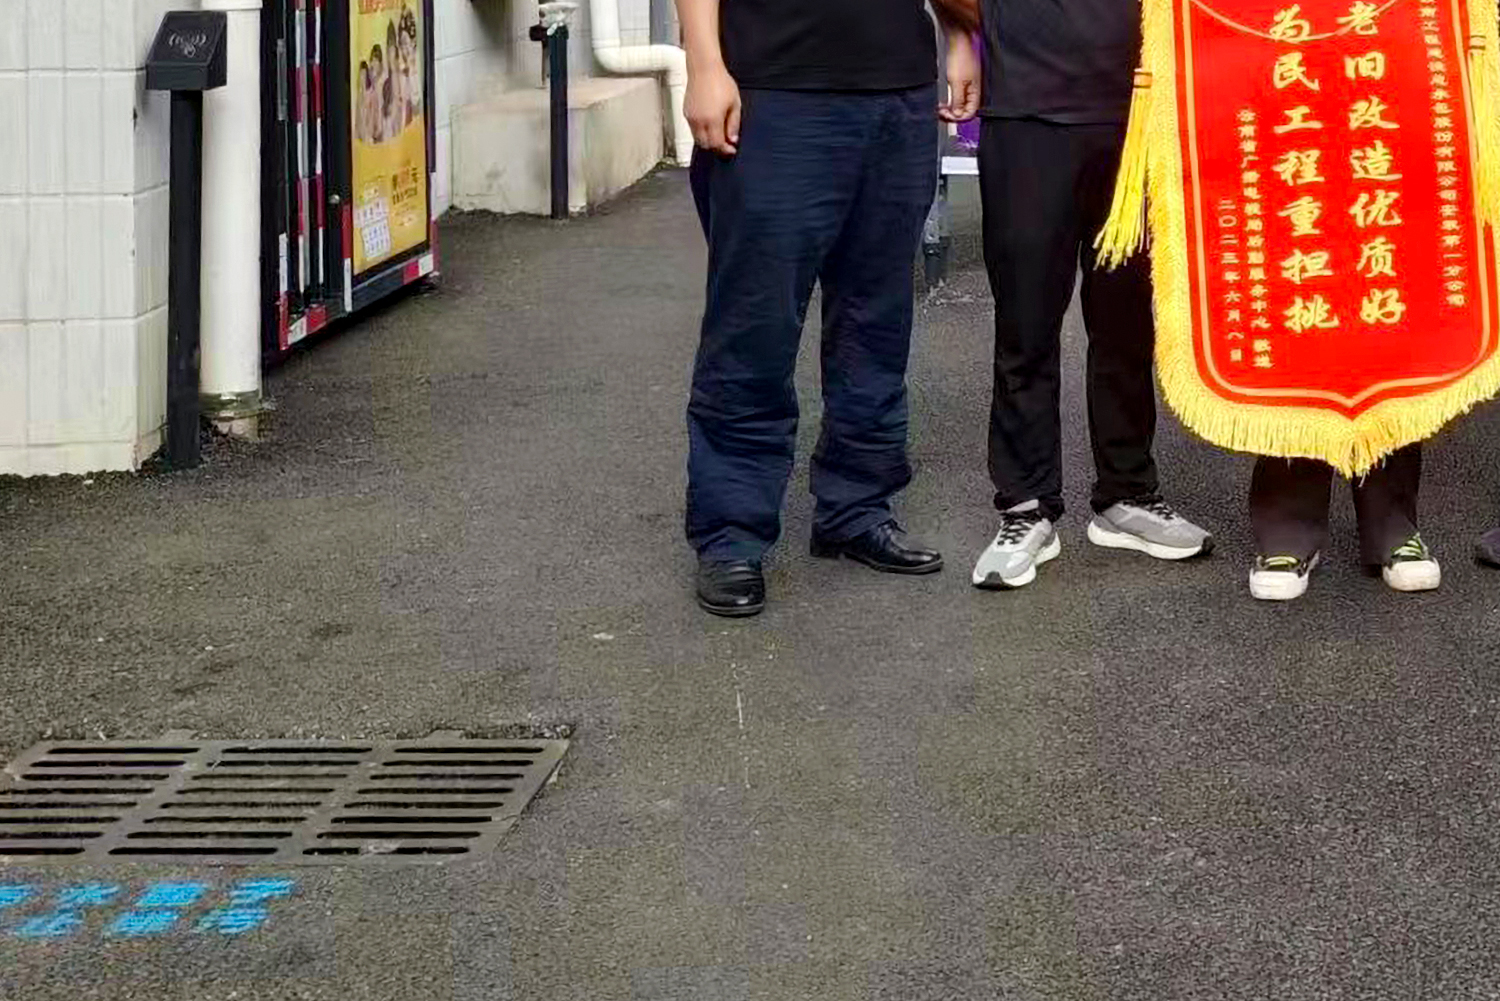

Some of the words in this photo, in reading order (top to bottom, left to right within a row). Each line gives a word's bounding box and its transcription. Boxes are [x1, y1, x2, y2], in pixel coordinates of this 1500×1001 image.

[1269, 3, 1340, 334] 为民工程重担挑
[1336, 0, 1407, 325] 老旧改造优质好
